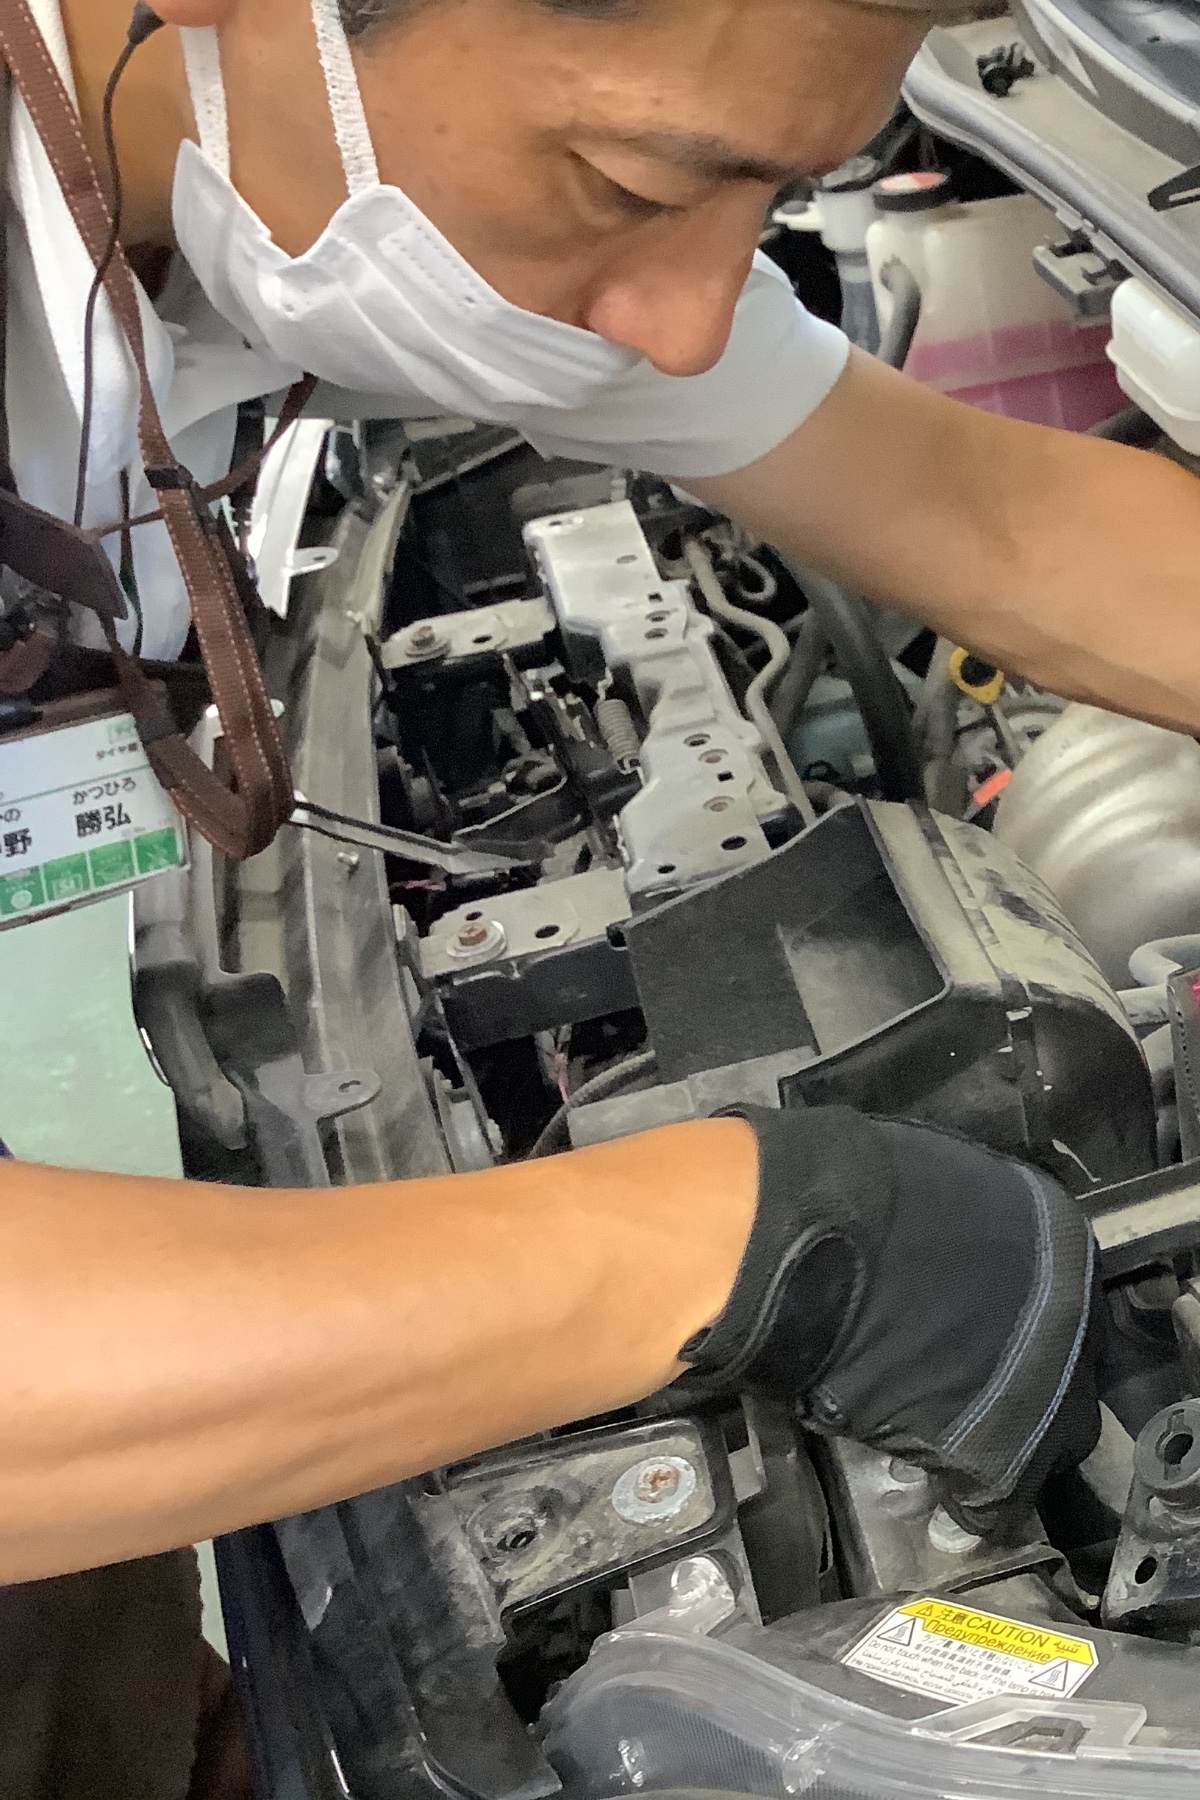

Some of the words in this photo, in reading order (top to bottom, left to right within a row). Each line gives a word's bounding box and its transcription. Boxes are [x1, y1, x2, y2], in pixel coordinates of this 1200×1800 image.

[0, 808, 21, 823] の
[73, 777, 136, 806] かつひろ
[0, 828, 32, 858] 野
[75, 802, 132, 838] 勝弘
[925, 1619, 1051, 1663] Предупреждение
[938, 1607, 967, 1626] 注意
[966, 1615, 1050, 1649] CAUTION
[868, 1640, 881, 1649] Do
[882, 1643, 898, 1653] not
[897, 1647, 921, 1661] touch
[921, 1655, 943, 1666] when
[944, 1662, 959, 1672] the
[960, 1666, 980, 1678] back
[981, 1673, 993, 1682] of
[993, 1676, 1008, 1686] the
[1008, 1682, 1029, 1694] lamp
